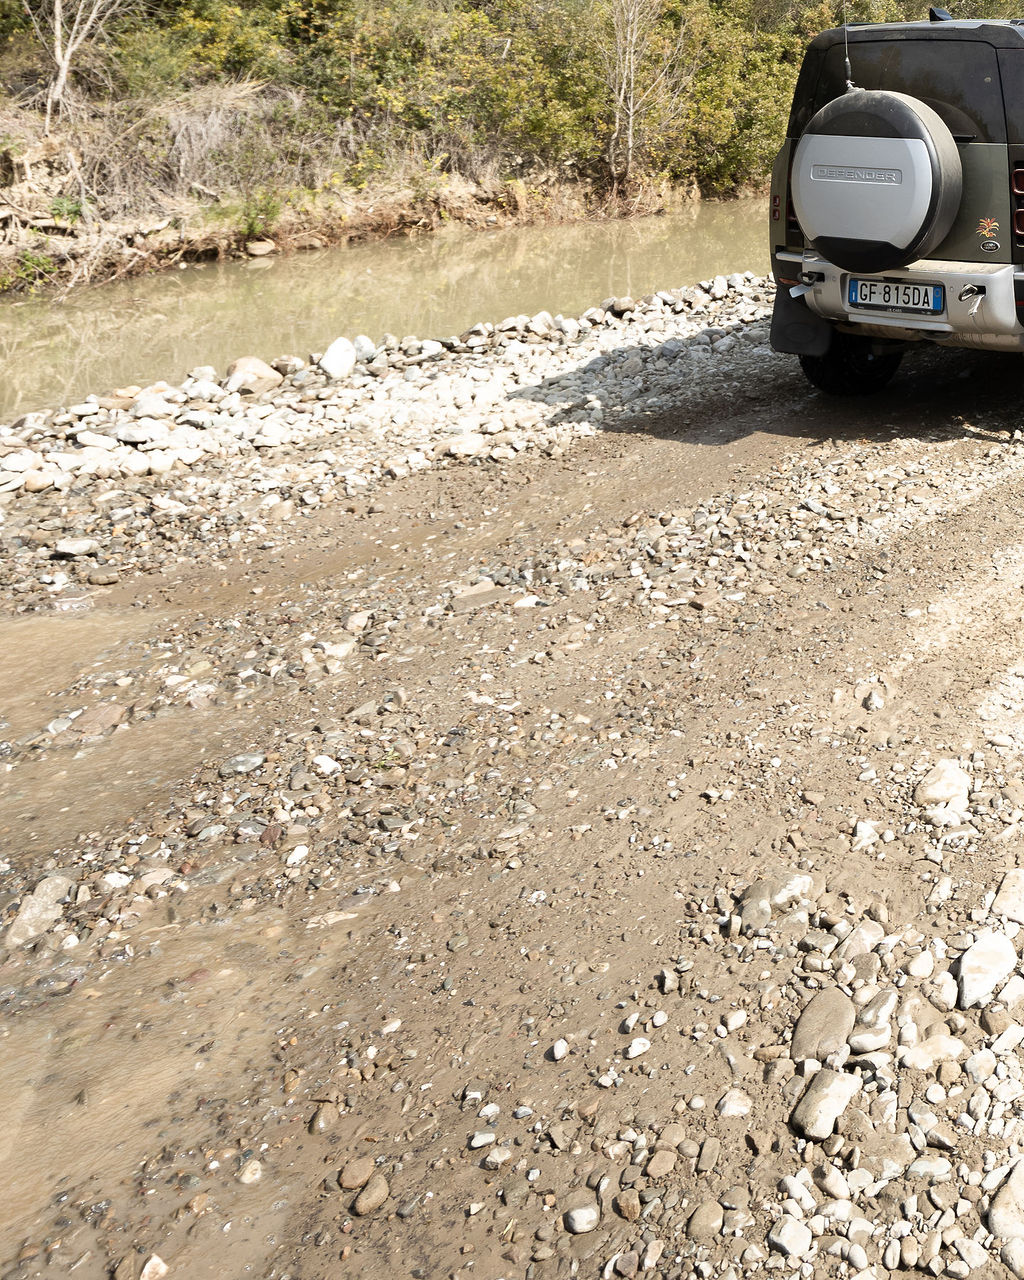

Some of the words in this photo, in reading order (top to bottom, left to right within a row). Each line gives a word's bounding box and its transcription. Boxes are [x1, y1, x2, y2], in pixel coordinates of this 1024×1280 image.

[818, 167, 896, 182] DEFENDER
[860, 283, 877, 302] GF
[883, 285, 930, 307] 815DA
